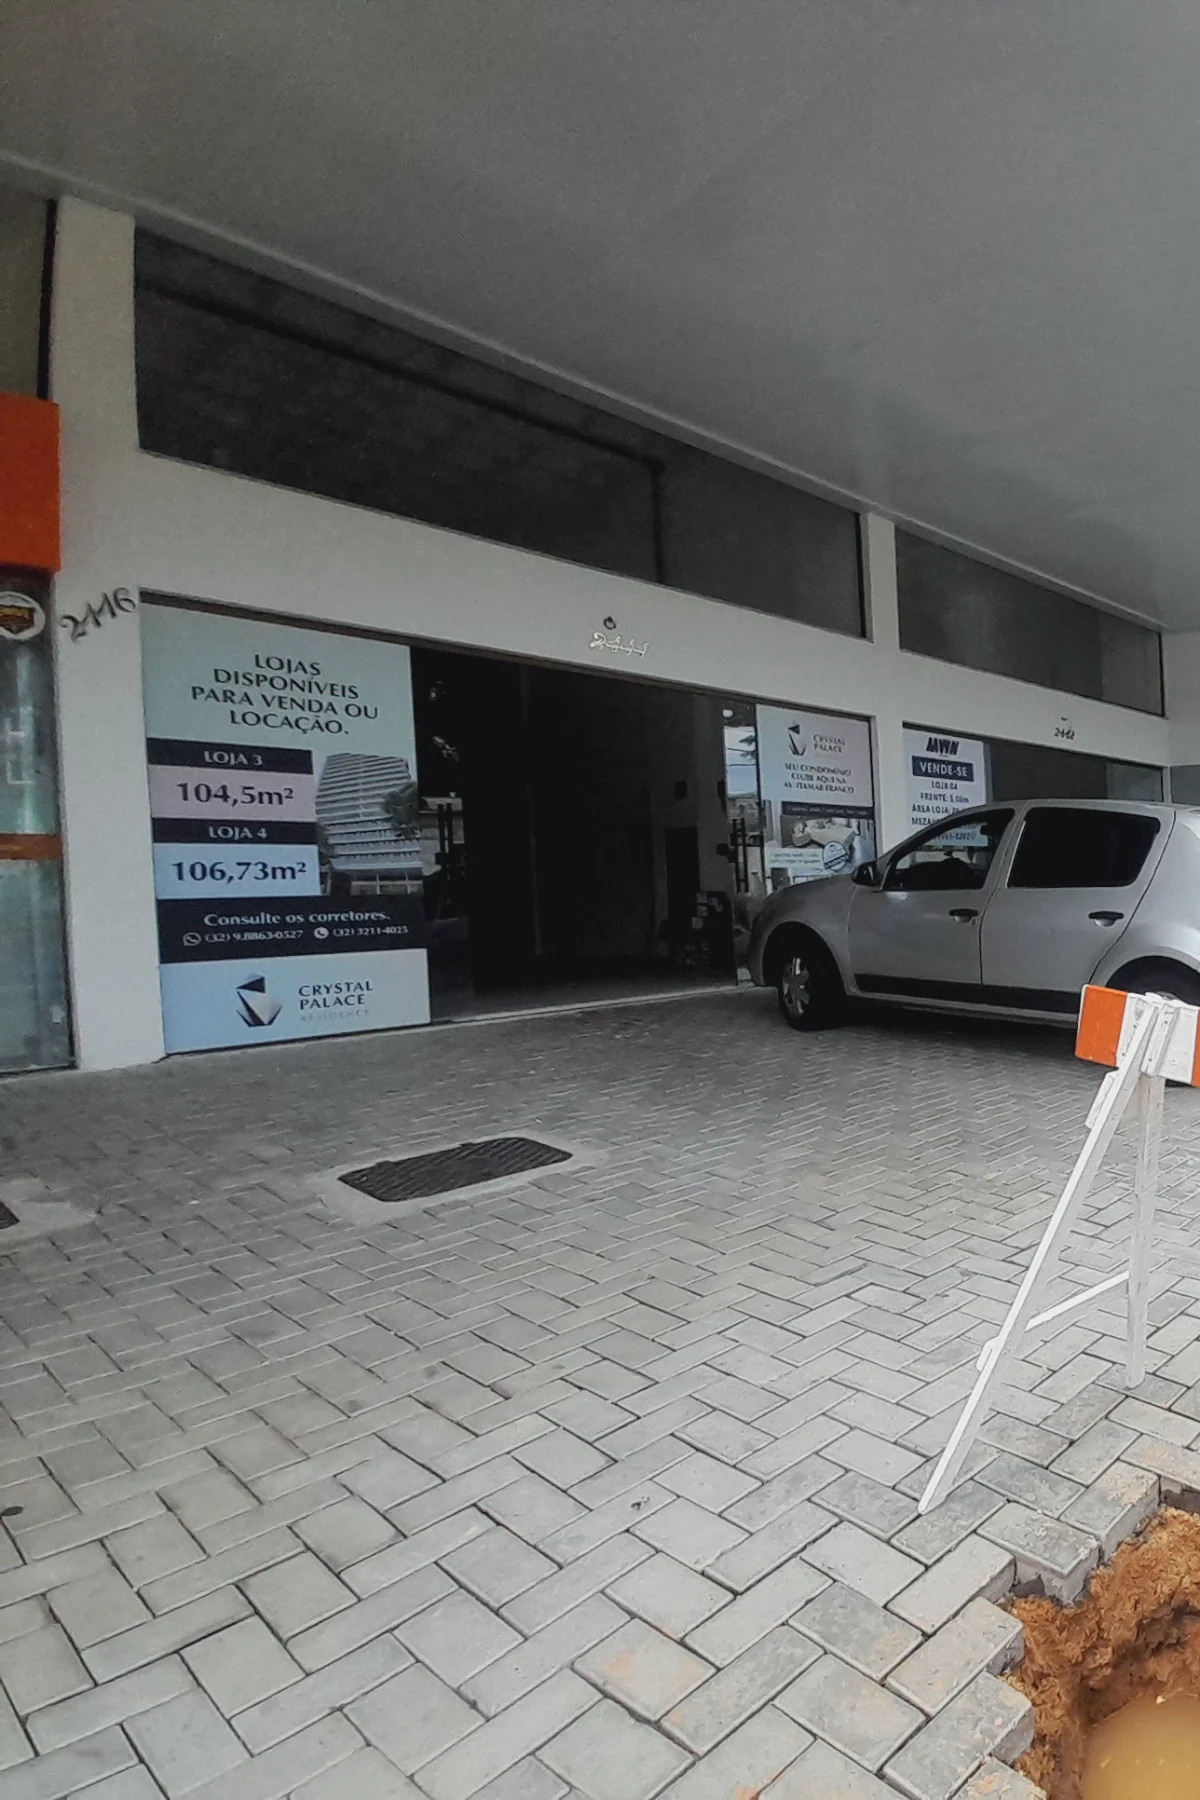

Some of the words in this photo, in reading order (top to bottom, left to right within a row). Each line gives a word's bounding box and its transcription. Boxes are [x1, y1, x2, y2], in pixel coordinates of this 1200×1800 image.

[254, 653, 321, 676] LOJAS
[213, 668, 359, 699] DISPONÍVEIS
[190, 685, 254, 706] PARA
[260, 693, 338, 715] VENDA
[344, 703, 378, 719] OU
[229, 709, 349, 735] LOCAÇÃO.
[813, 743, 842, 754] PALACE
[204, 750, 248, 766] LOJA
[253, 754, 263, 765] 3
[919, 761, 968, 777] VENDE-SE
[931, 780, 949, 790] LOJA
[208, 825, 252, 840] LOJA
[256, 827, 267, 839] 4
[203, 911, 282, 926] Consulte
[285, 913, 305, 923] os
[308, 910, 391, 923] corretores.
[298, 980, 374, 997] CRYSTAL
[299, 993, 366, 1010] PALACE
